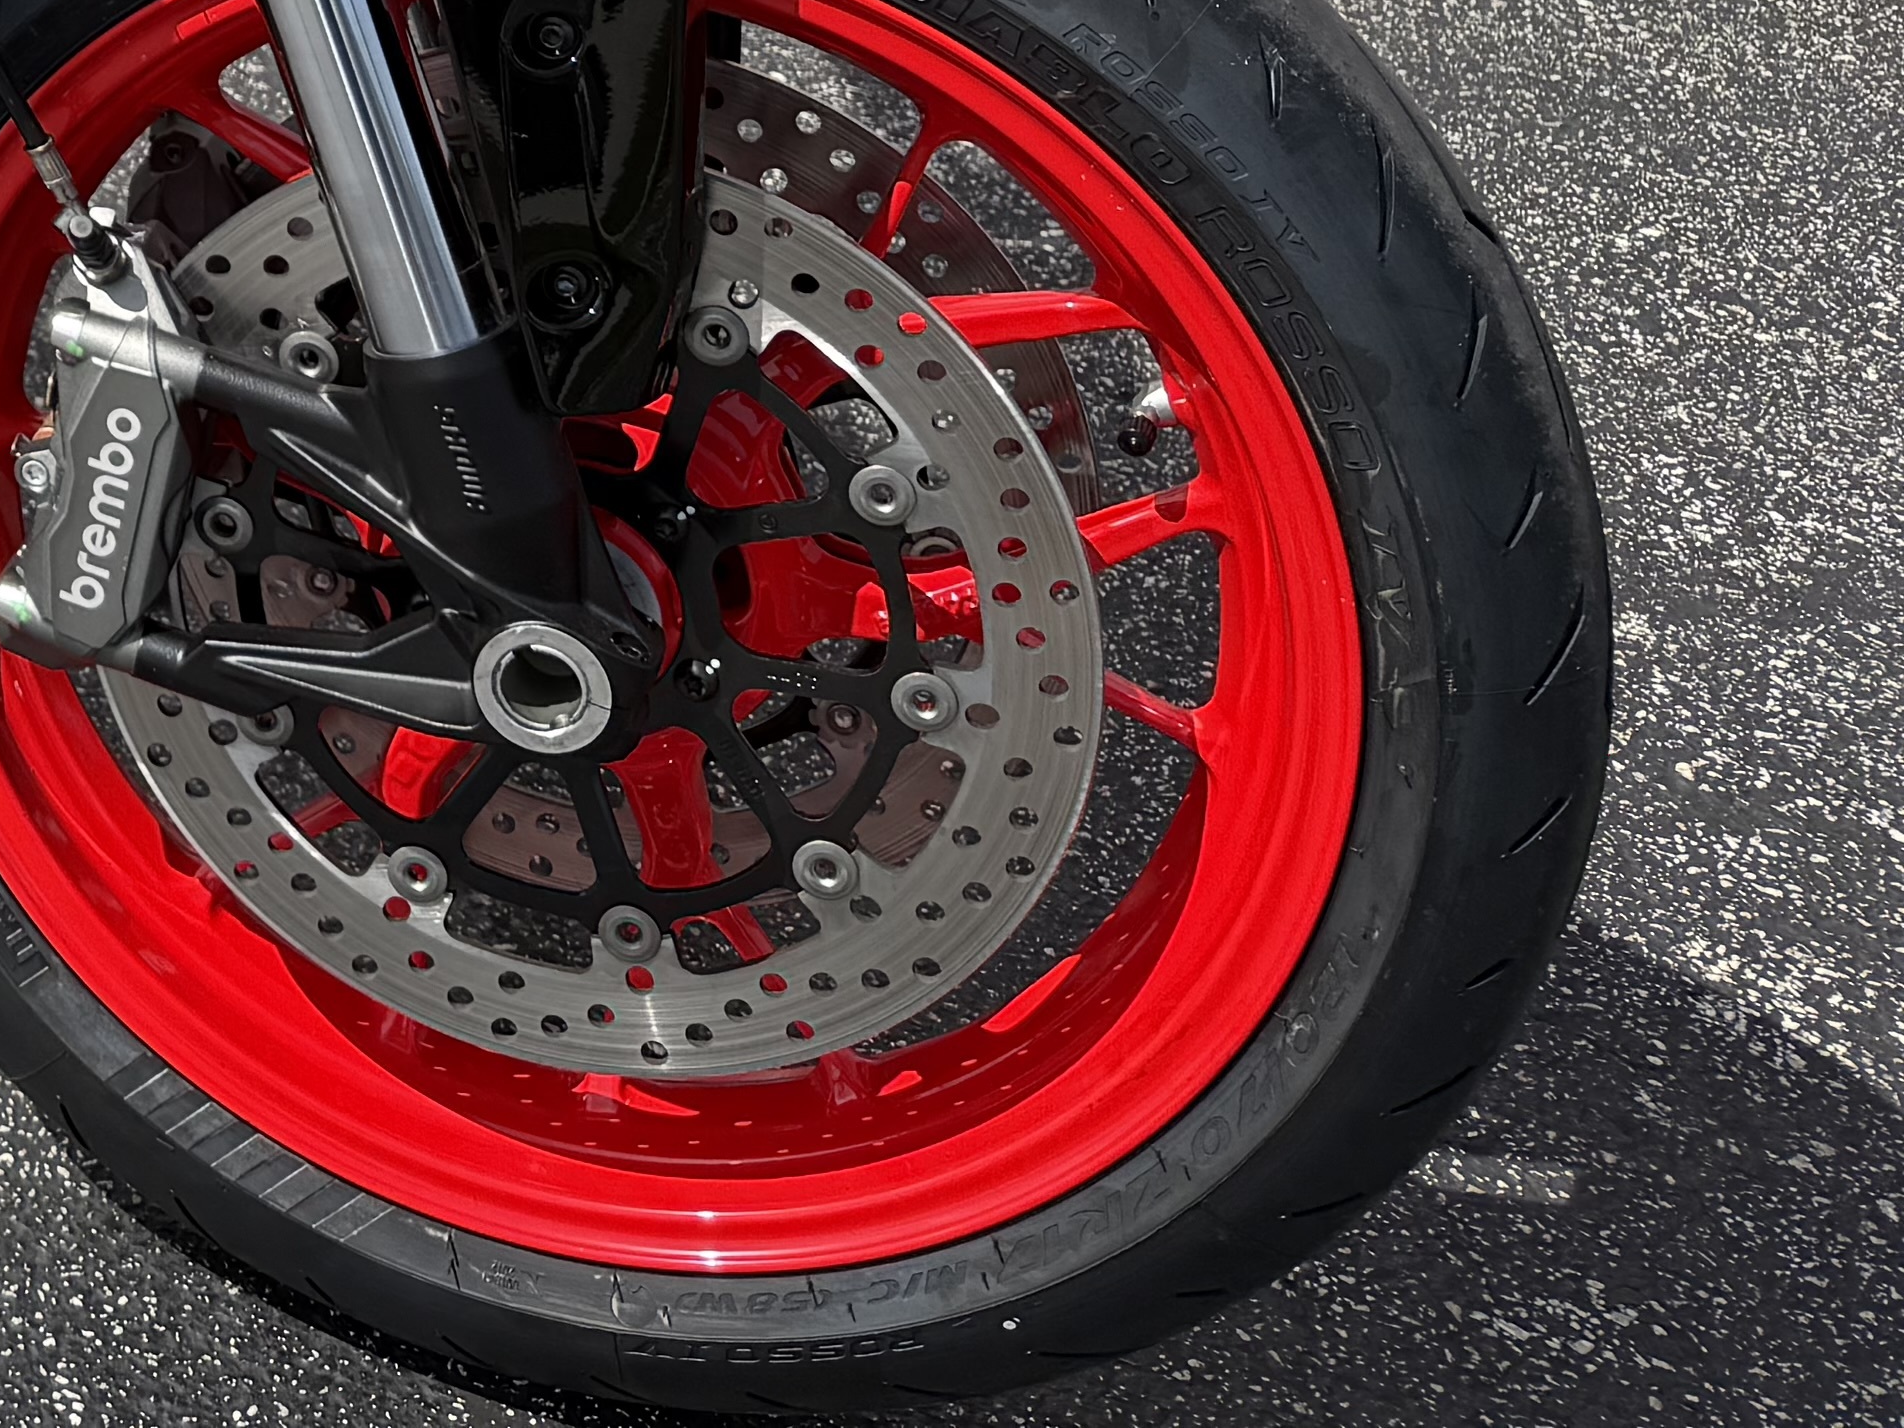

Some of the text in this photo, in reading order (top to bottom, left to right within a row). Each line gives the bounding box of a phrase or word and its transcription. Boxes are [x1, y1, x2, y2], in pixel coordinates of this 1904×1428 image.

[1062, 20, 1252, 183] ROSSO
[1196, 206, 1382, 474] ROSSO
[58, 406, 142, 610] brembo
